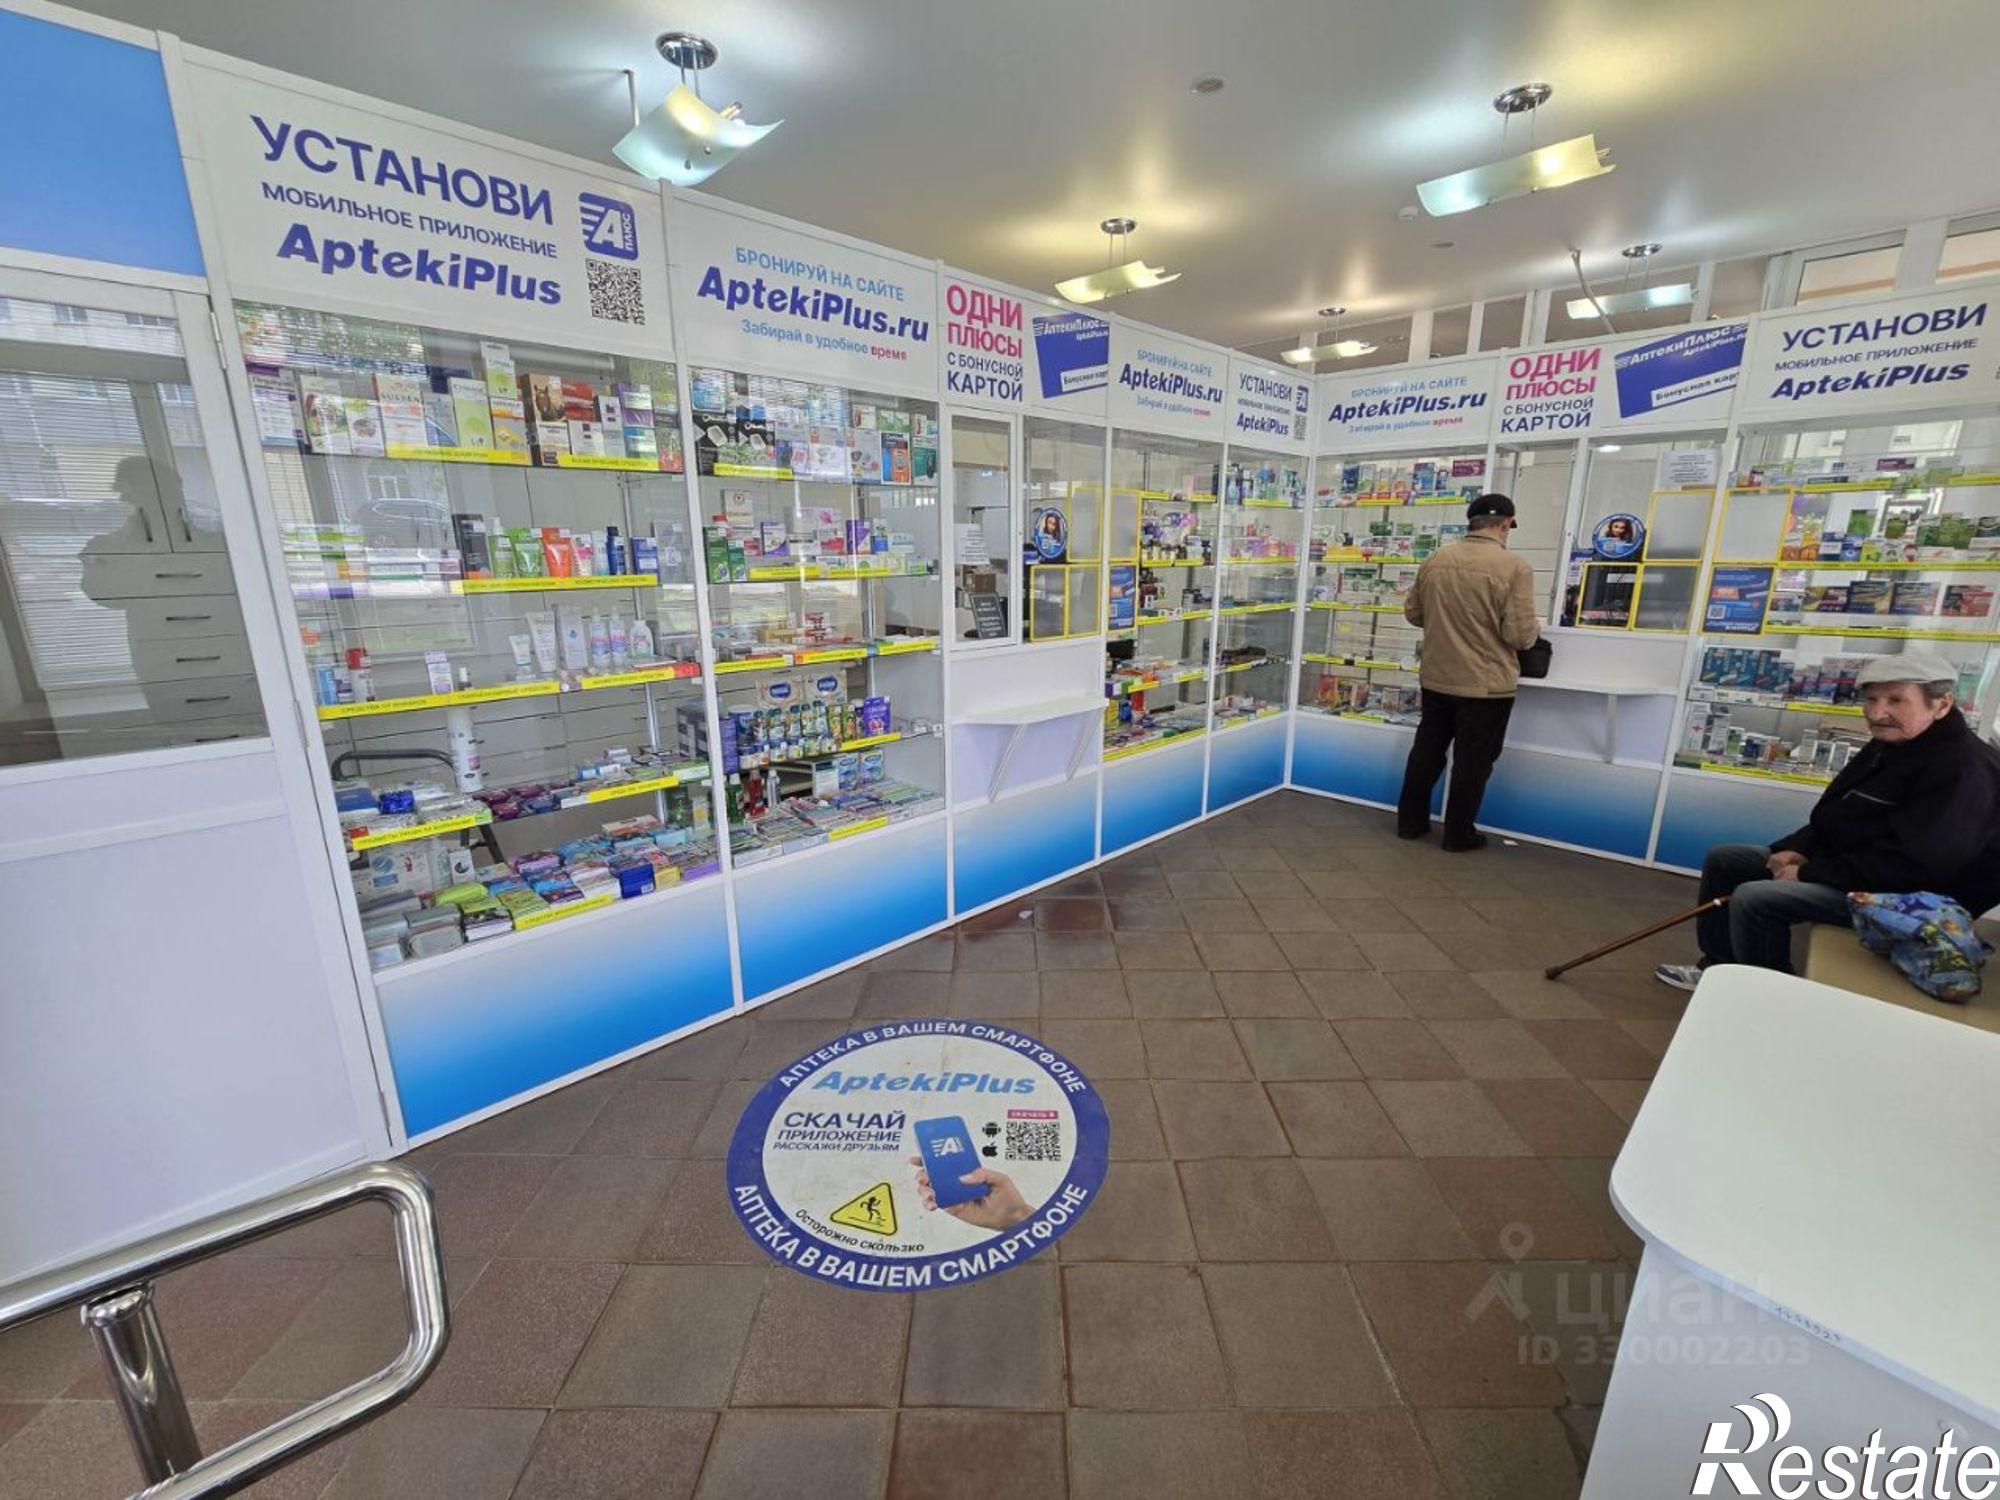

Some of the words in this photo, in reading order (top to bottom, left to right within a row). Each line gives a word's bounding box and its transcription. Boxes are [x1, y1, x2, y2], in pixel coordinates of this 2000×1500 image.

[250, 114, 554, 225] УСТАНОВИ
[262, 182, 413, 228] МОБИЛЬНОЕ
[419, 215, 558, 258] ПРИЛОЖЕНИЕ
[276, 223, 562, 305] AptekiPlus
[735, 246, 828, 285] БРОНИРУЙ
[830, 272, 852, 289] НА
[856, 276, 905, 302] САЙТЕ
[697, 265, 929, 342] AptekiPlus.ru
[945, 284, 1023, 332] ОДНИ
[741, 318, 802, 342] Забирай
[804, 333, 813, 345] в
[815, 334, 869, 355] удобное
[870, 345, 908, 361] время
[947, 322, 1023, 359] ПЛЮСЫ
[1781, 303, 1988, 352] УСТАНОВИ
[958, 354, 1024, 380] БОНУСНОЙ
[1508, 347, 1602, 382] ОДНИ
[1774, 351, 1863, 372] МОБИЛЬНОЕ
[1866, 337, 1979, 362] ПРИЛОЖЕНИЕ
[946, 371, 1023, 402] КАРТОЙ
[1119, 363, 1223, 403] AptekiPlus.ru
[1239, 372, 1293, 402] УСТАНОВИ
[1410, 380, 1426, 391] НА
[1429, 376, 1467, 390] САЙТЕ
[1506, 376, 1597, 401] ПЛЮСЫ
[1770, 363, 1971, 401] AptekiPlus
[1328, 392, 1488, 424] AptekiPlus.ru
[1500, 408, 1592, 434] КАРТОЙ
[1516, 397, 1594, 413] БОНУСНОЙ
[1236, 412, 1289, 435] AptekiPlus
[780, 1037, 860, 1087] АПТЕКА
[862, 1030, 878, 1041] В
[882, 1022, 967, 1038] ВАШЕМ
[971, 1025, 1086, 1093] СМАРТФОНЕ
[811, 1070, 1036, 1096] AptekiPlus
[777, 1129, 902, 1142] ПРИЛОЖЕНИЕ
[784, 1110, 906, 1129] СКАЧАЙ
[773, 1141, 841, 1151] РАССКАЖИ
[843, 1142, 900, 1152] ДРУЗЬЯМ
[734, 1184, 800, 1259] АПТЕКА
[797, 1246, 821, 1268] В
[817, 1254, 932, 1287] ВАШЕМ
[938, 1183, 1088, 1283] СМАРТФОНЕ
[796, 1208, 858, 1246] Осторожно
[860, 1240, 924, 1252] скользко
